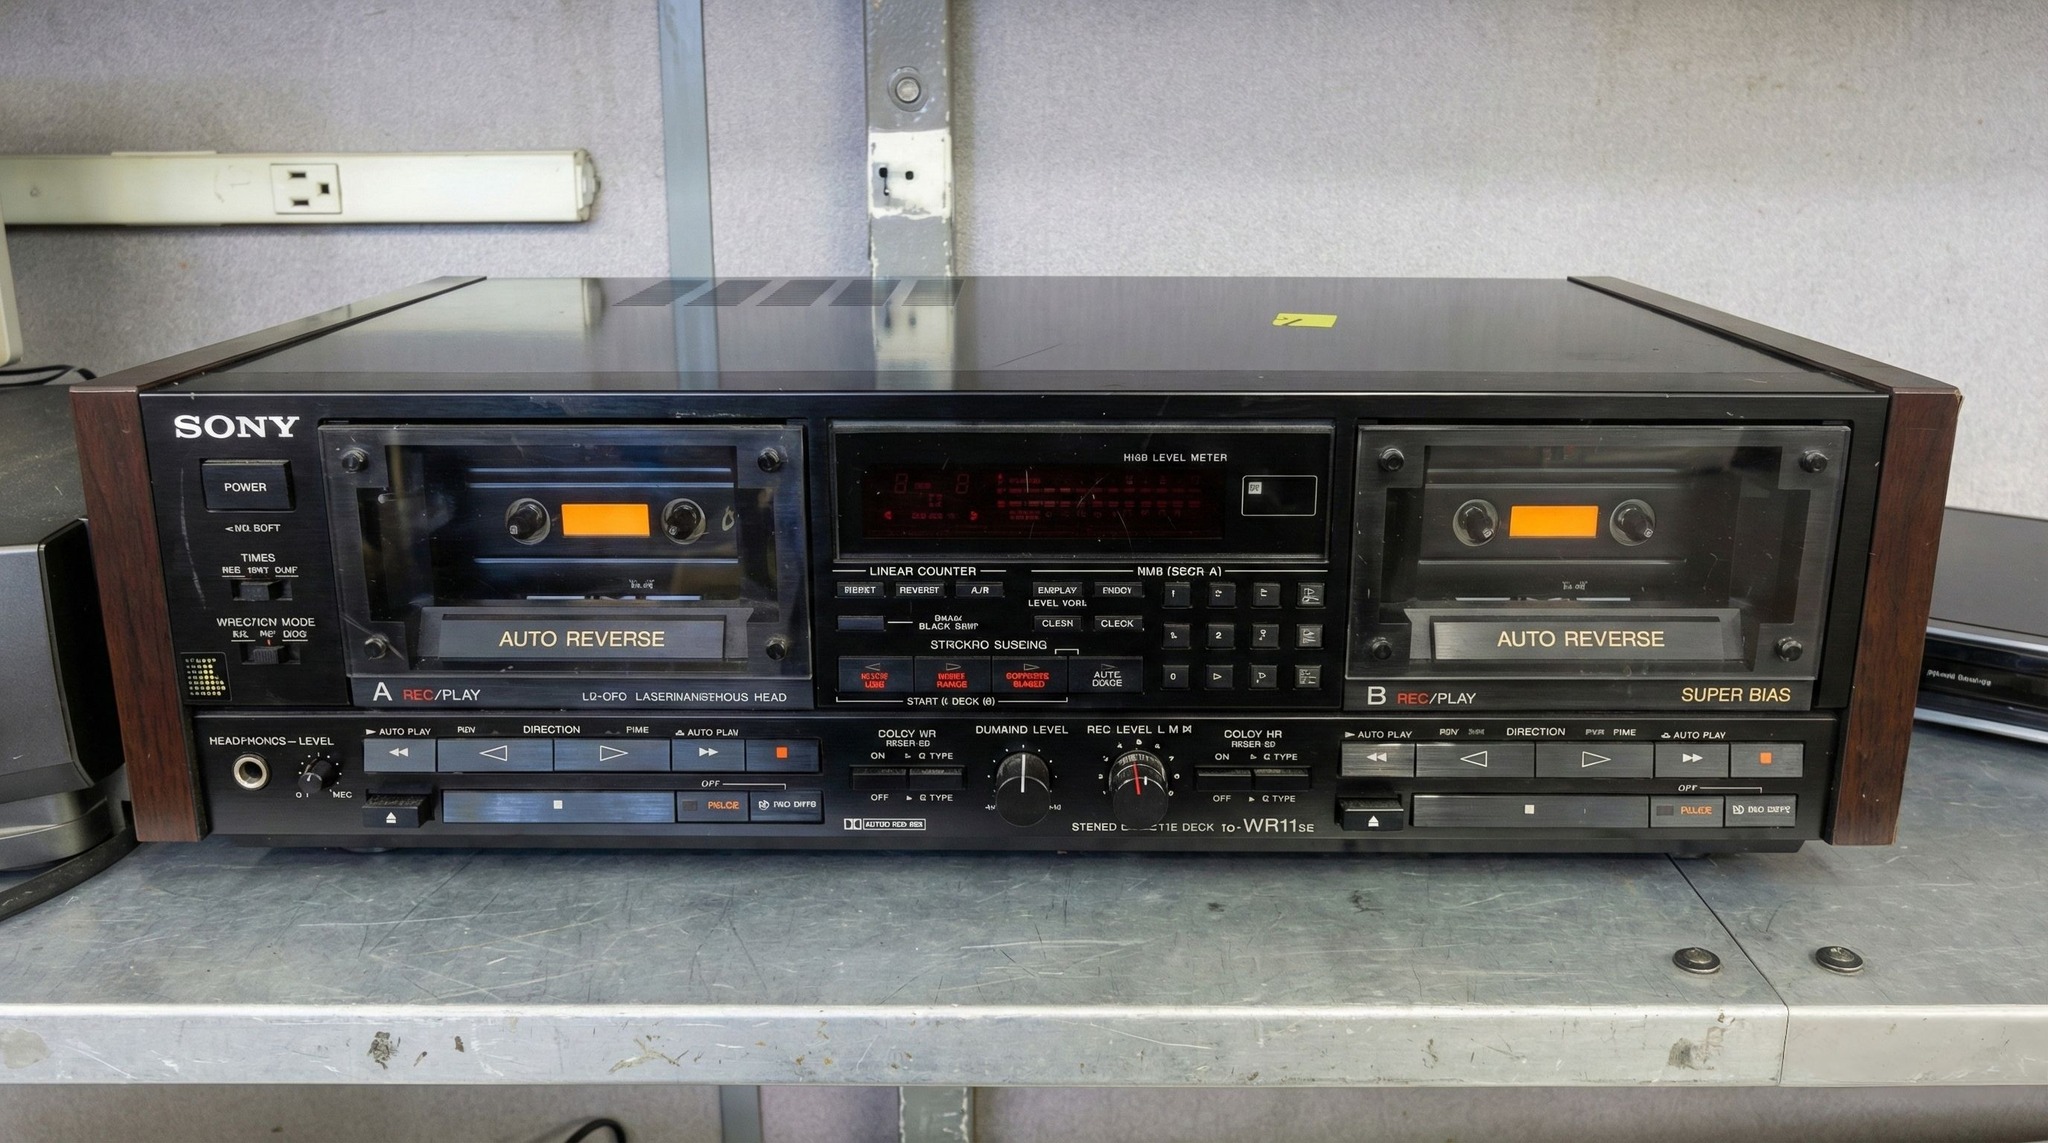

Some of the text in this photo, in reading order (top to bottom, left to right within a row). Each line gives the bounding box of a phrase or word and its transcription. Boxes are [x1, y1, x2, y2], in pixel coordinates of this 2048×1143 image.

[174, 415, 299, 438] SONY
[1191, 454, 1227, 462] METER
[224, 483, 267, 492] POWER
[241, 553, 276, 562] TIMES
[869, 567, 976, 576] LINEAR COUNTER
[1028, 599, 1058, 607] LEVEL
[282, 618, 316, 627] MODE
[499, 631, 665, 647] AUTO REVERSE
[1497, 630, 1665, 647] AUTO REVERSE
[373, 682, 481, 701] A REC/PLAY
[1367, 686, 1476, 705] B REC/PLAY
[1681, 688, 1791, 702] SUPER BIAS
[754, 693, 787, 702] HEAD
[907, 697, 938, 706] START
[952, 697, 979, 705] DECK
[379, 728, 431, 736] AUTO PLAY
[523, 725, 580, 734] DIRECTION
[919, 730, 937, 738] WR
[1033, 725, 1068, 734] LEVEL
[1087, 725, 1111, 734] REC
[1117, 725, 1152, 734] LEVEL
[1267, 730, 1282, 738] HR
[1506, 727, 1566, 736] DIRECTION
[1613, 728, 1636, 736] PIME
[1673, 731, 1726, 739] AUTO PLAY
[298, 736, 334, 746] LEVEL
[1182, 823, 1214, 831] DECK
